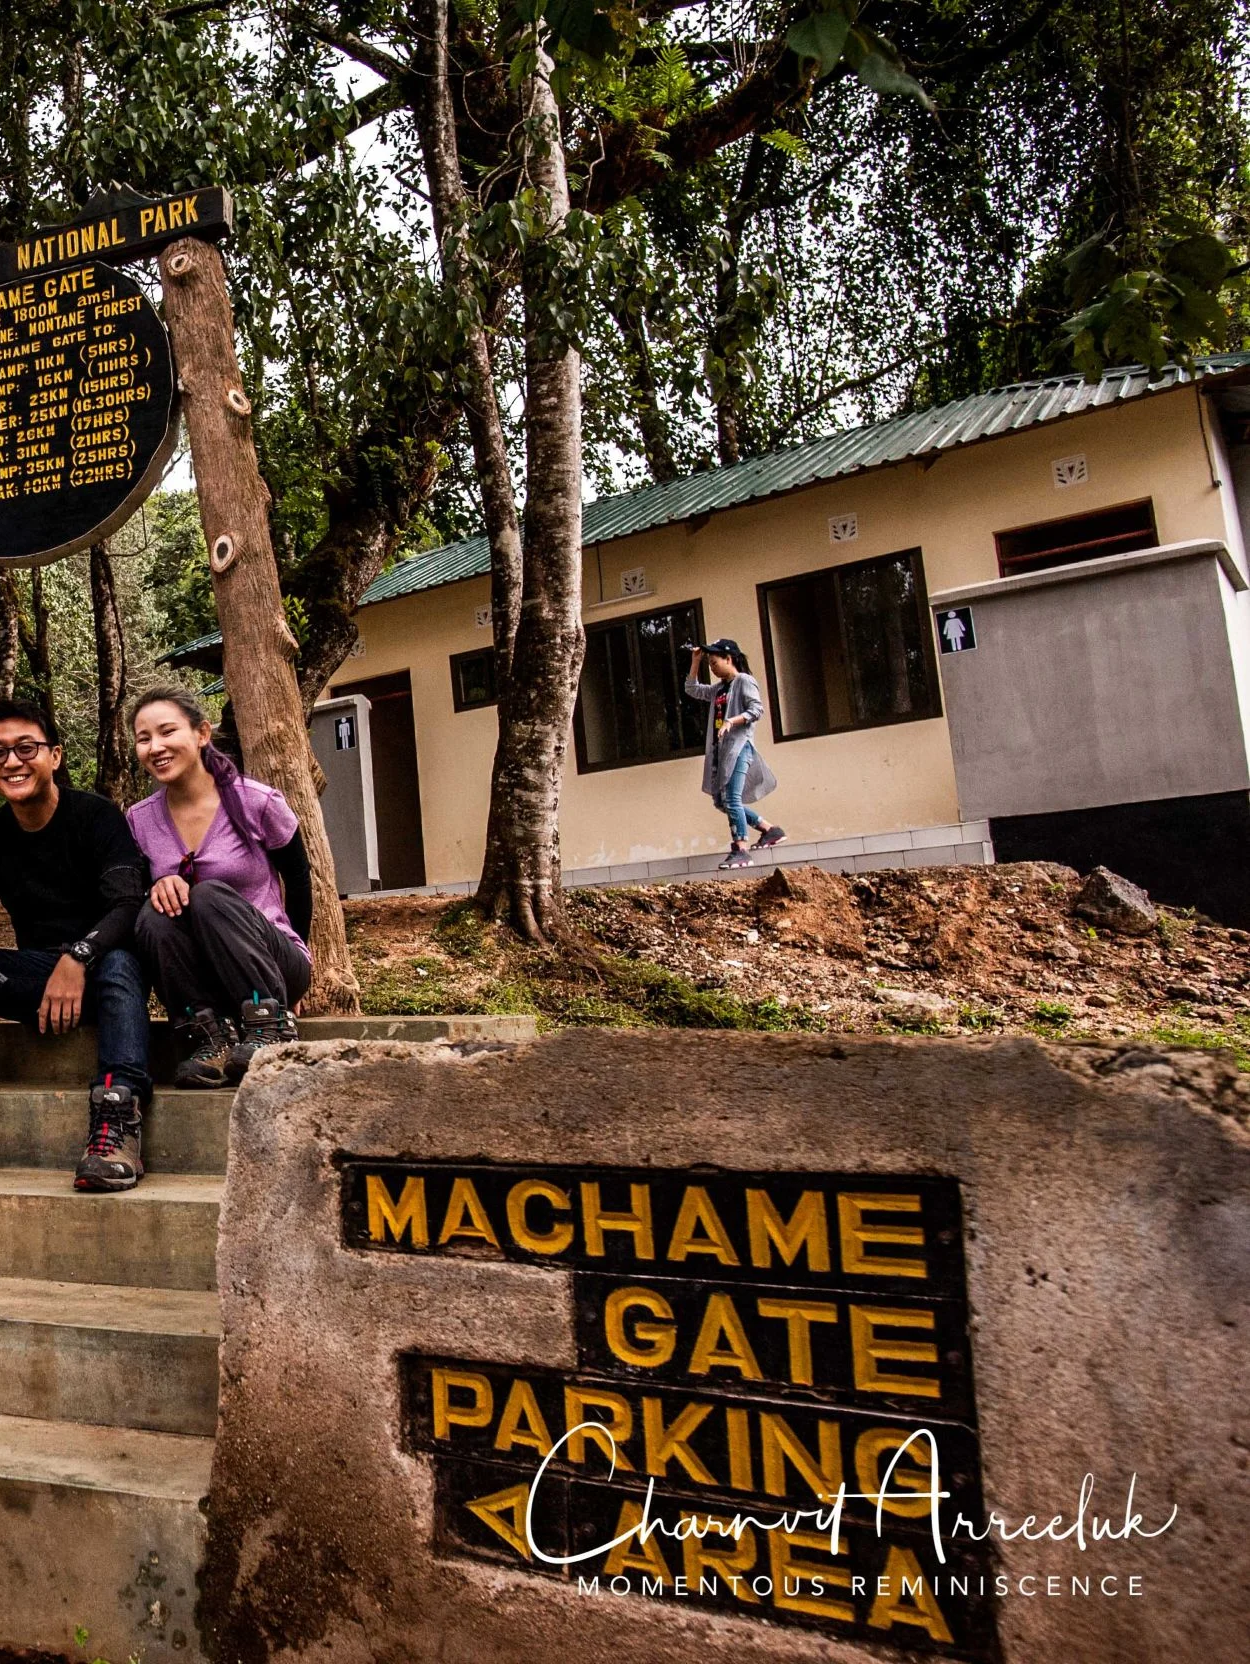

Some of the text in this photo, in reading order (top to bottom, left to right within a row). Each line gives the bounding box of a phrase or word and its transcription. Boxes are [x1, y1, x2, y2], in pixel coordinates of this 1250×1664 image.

[17, 217, 126, 271] NATIONAL
[140, 195, 199, 237] PARK
[44, 267, 96, 298] GATE
[13, 299, 58, 324] 1800M
[77, 284, 115, 307] amsl
[29, 309, 86, 337] MONTANE
[94, 295, 143, 320] FOREST
[34, 353, 65, 371] 11KM
[79, 332, 135, 365] (5HRS)
[52, 330, 87, 348] GATE
[93, 323, 116, 338] TO:
[29, 387, 69, 407] 23KM
[79, 367, 135, 397] (15HRS)
[37, 368, 73, 388] 16KM
[29, 403, 68, 424] 25KM
[72, 382, 151, 414] (16.30HRS)
[16, 423, 56, 443] 26KM
[71, 405, 129, 433] (17HRS)
[16, 442, 50, 460] 31KM
[70, 423, 129, 451] (21HRS)
[23, 473, 62, 496] 40KM
[70, 457, 133, 488] (32HRS)
[26, 456, 65, 474] 35KM
[72, 439, 136, 467] (25HRS)
[364, 1174, 928, 1280] MACHAME
[604, 1285, 943, 1400] GATE
[430, 1367, 943, 1519] PARKING
[602, 1499, 955, 1644] AREA
